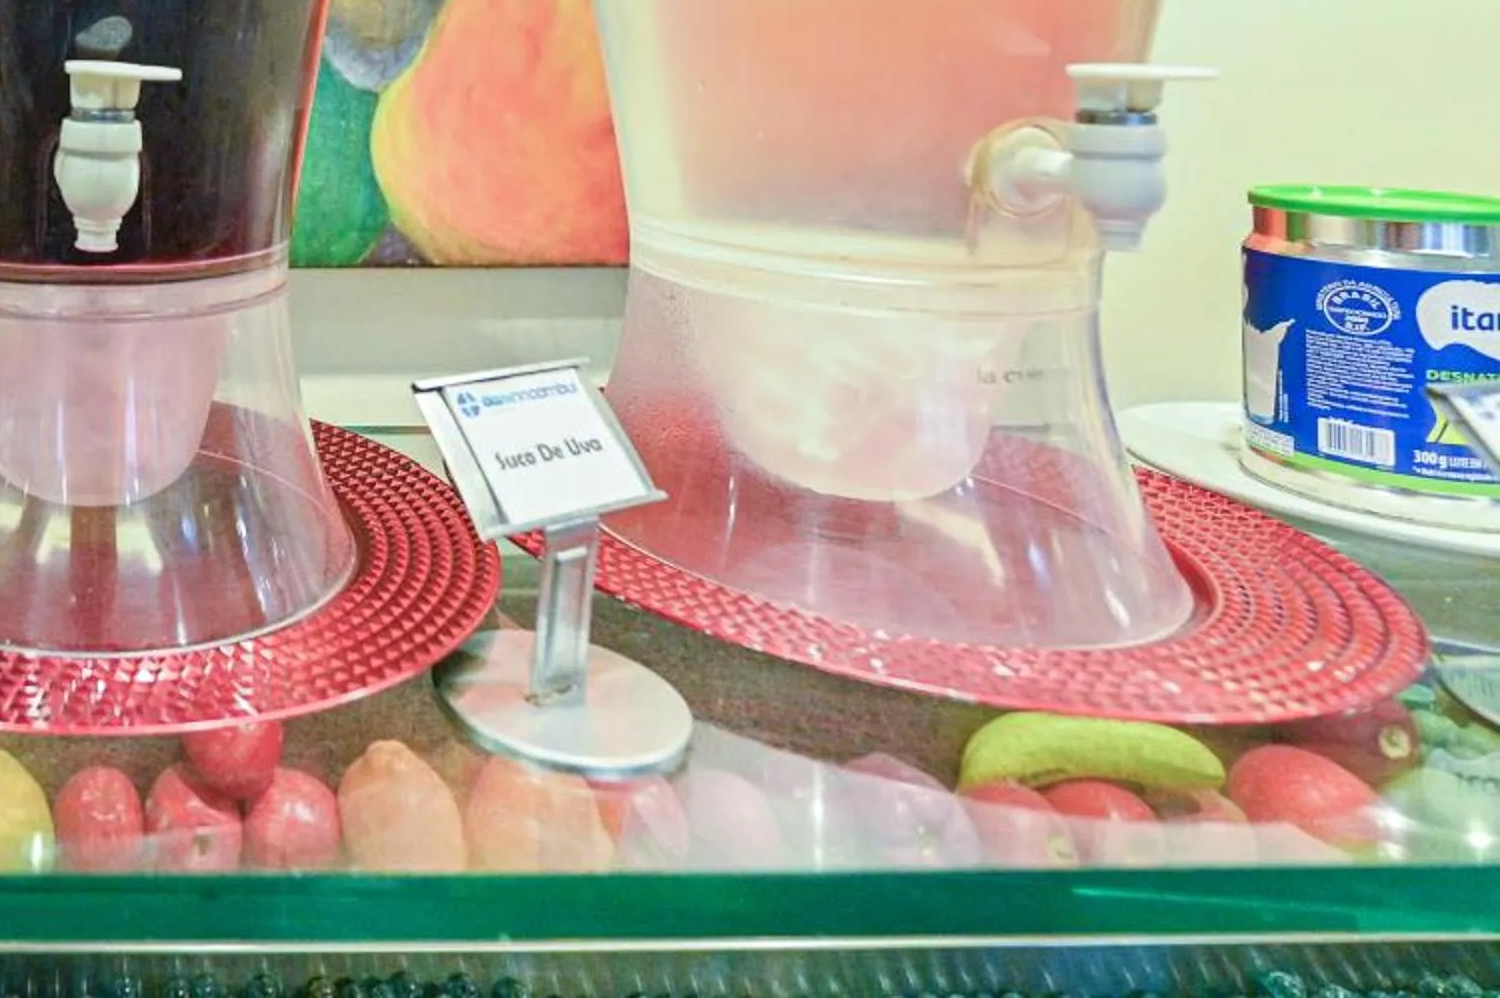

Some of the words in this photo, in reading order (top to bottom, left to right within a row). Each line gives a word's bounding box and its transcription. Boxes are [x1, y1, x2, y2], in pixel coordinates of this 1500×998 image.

[1450, 304, 1500, 331] ita
[537, 443, 565, 463] De
[565, 437, 604, 457] Uva
[1412, 449, 1437, 465] 300
